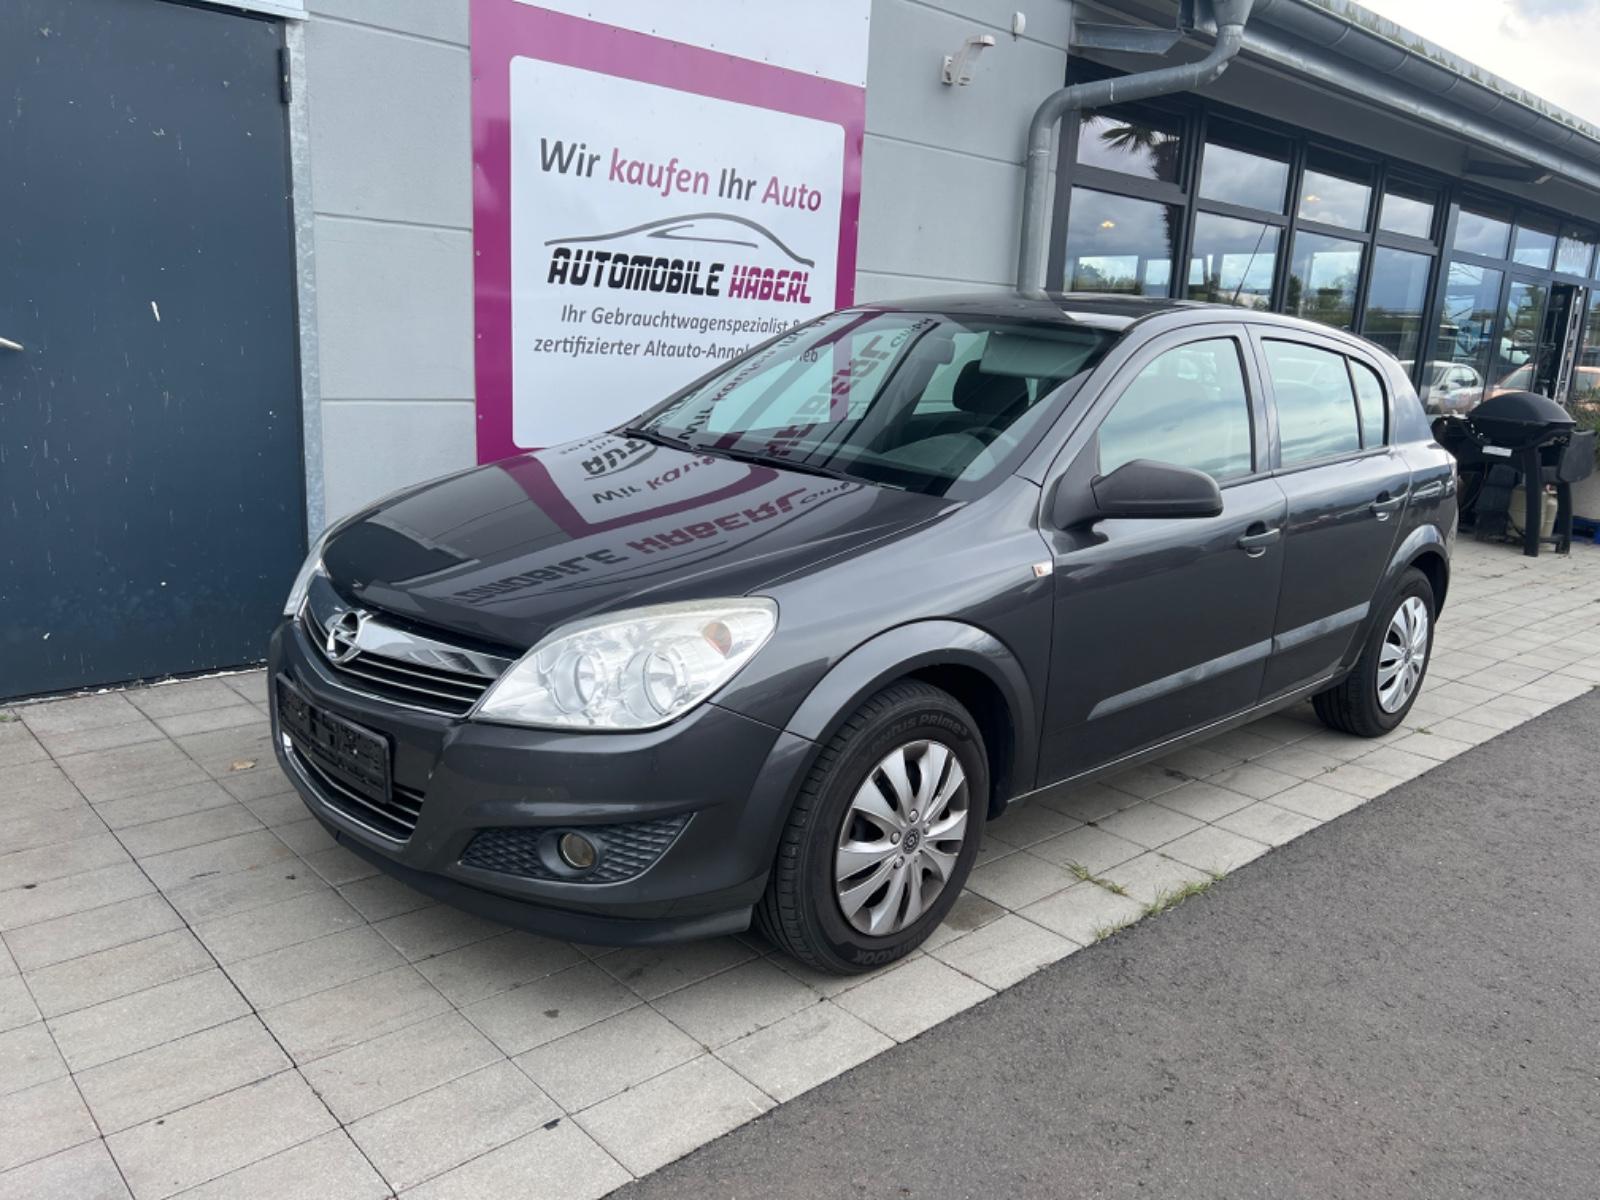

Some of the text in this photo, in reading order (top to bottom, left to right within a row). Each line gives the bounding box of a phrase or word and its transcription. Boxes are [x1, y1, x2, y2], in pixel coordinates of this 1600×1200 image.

[540, 138, 822, 212] Wir kaufen Ihr Auto
[547, 247, 812, 304] AUTOMOBILE HABERL
[561, 304, 587, 323] Ihr
[591, 307, 788, 335] Gebrauchtwagenspezialist
[534, 335, 641, 358] zertifizierter
